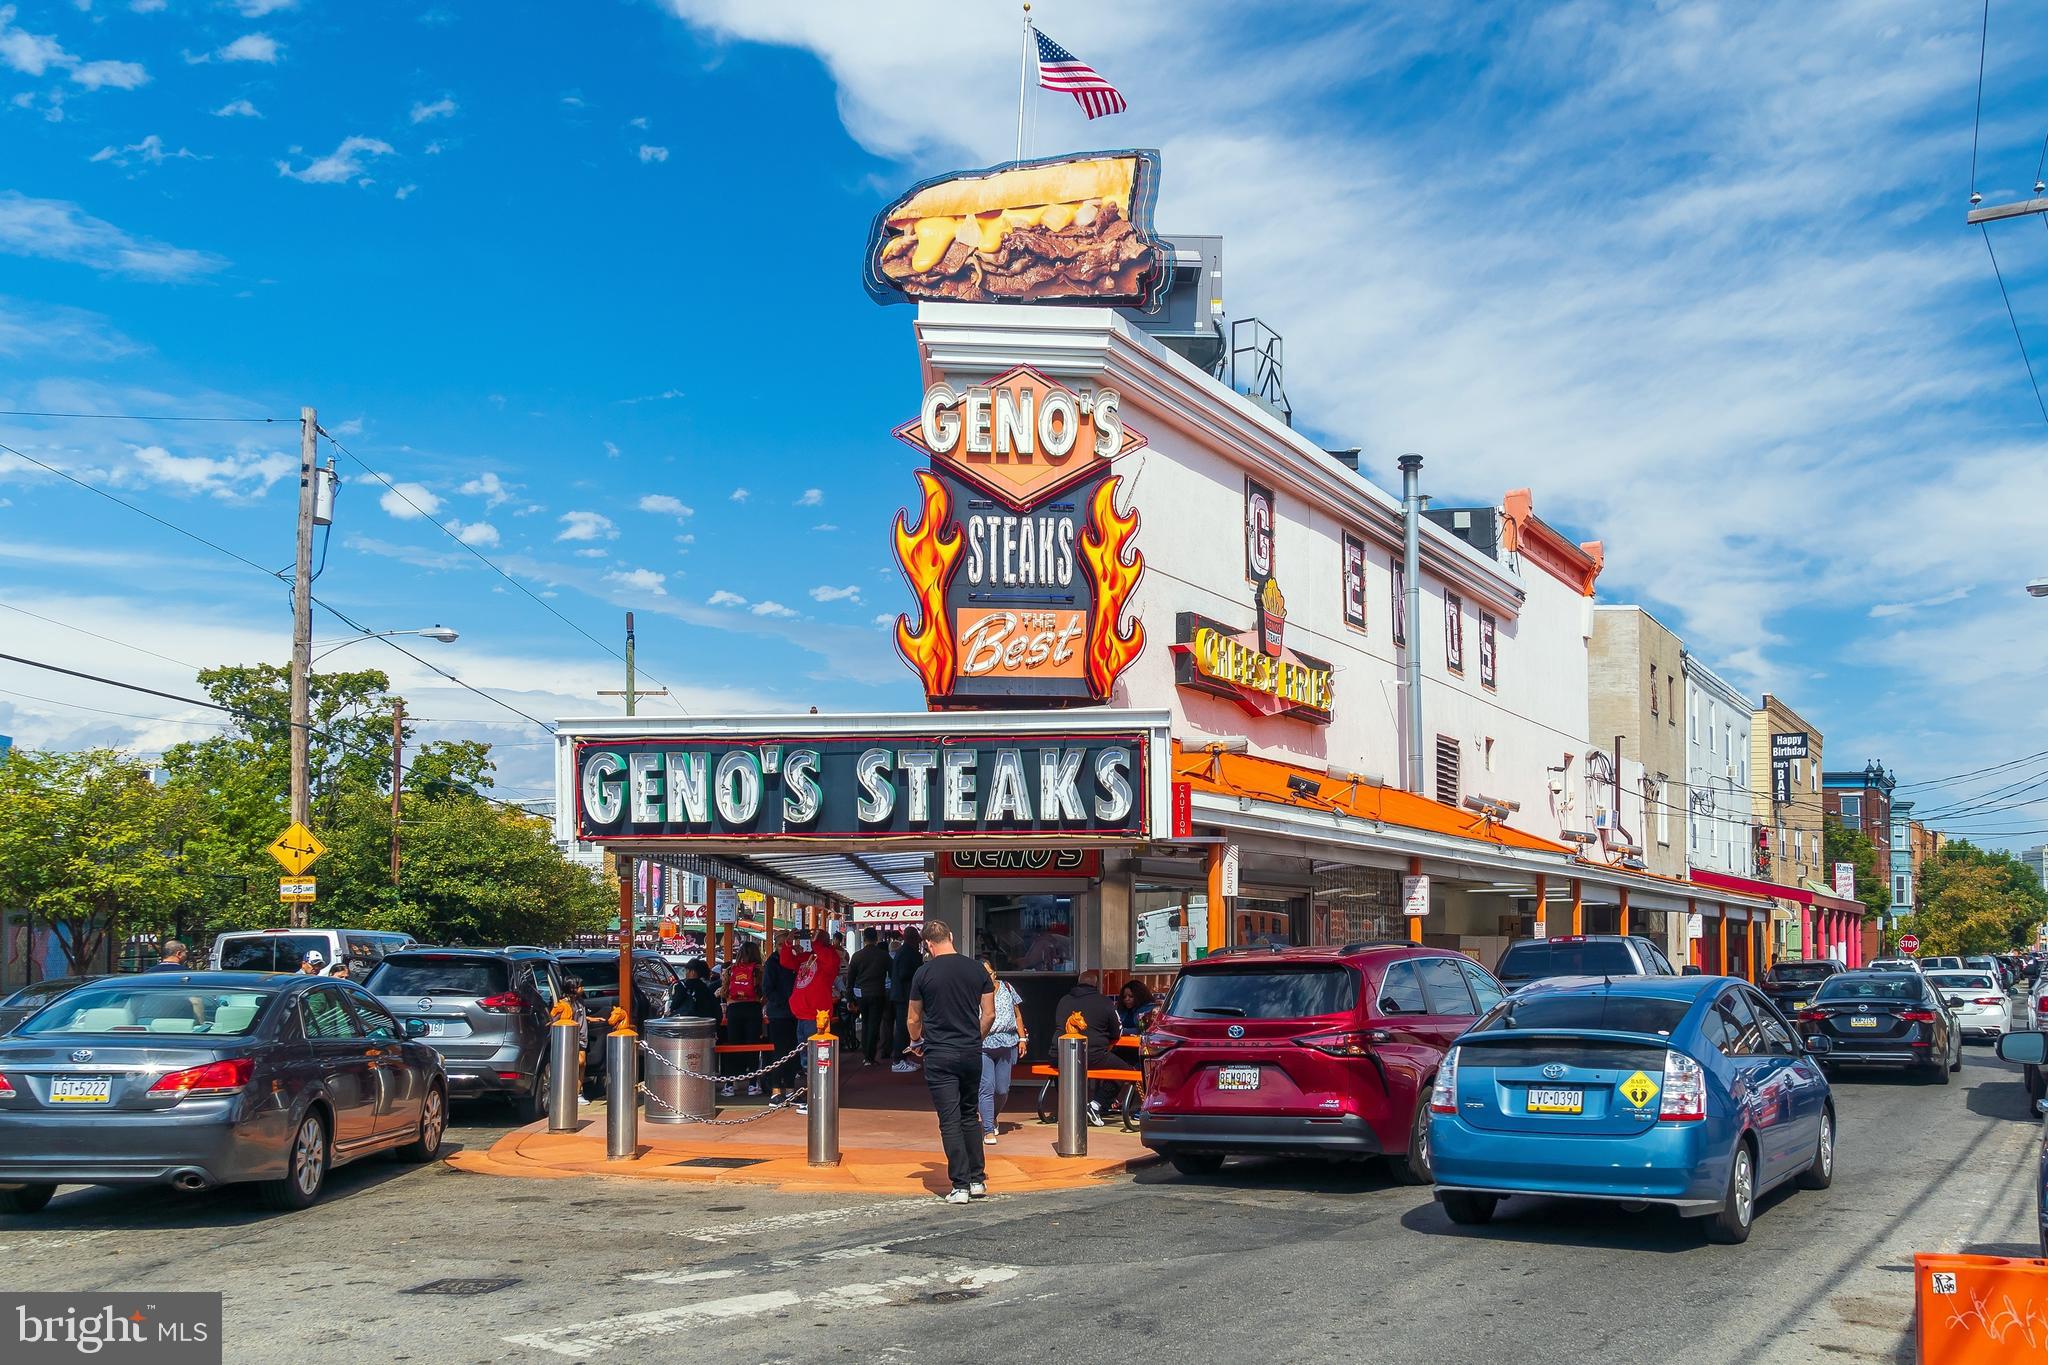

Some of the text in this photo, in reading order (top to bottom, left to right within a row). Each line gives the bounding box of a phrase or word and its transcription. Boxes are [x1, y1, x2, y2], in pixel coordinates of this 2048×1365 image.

[921, 382, 1124, 458] GENO'S
[967, 514, 1074, 588] STEAKS
[1021, 612, 1056, 628] THE
[962, 611, 1082, 674] Best
[1196, 627, 1335, 712] CHEESE FRIES
[1776, 735, 1802, 746] Happy
[1772, 746, 1807, 757] Birthday
[1773, 761, 1789, 769] Ray's
[582, 744, 1134, 826] GENO'S STEAKS
[1777, 769, 1786, 801] BAR
[953, 849, 1083, 869] GENOS
[292, 885, 303, 894] 25
[863, 909, 899, 919] King
[1900, 940, 1918, 948] STOP
